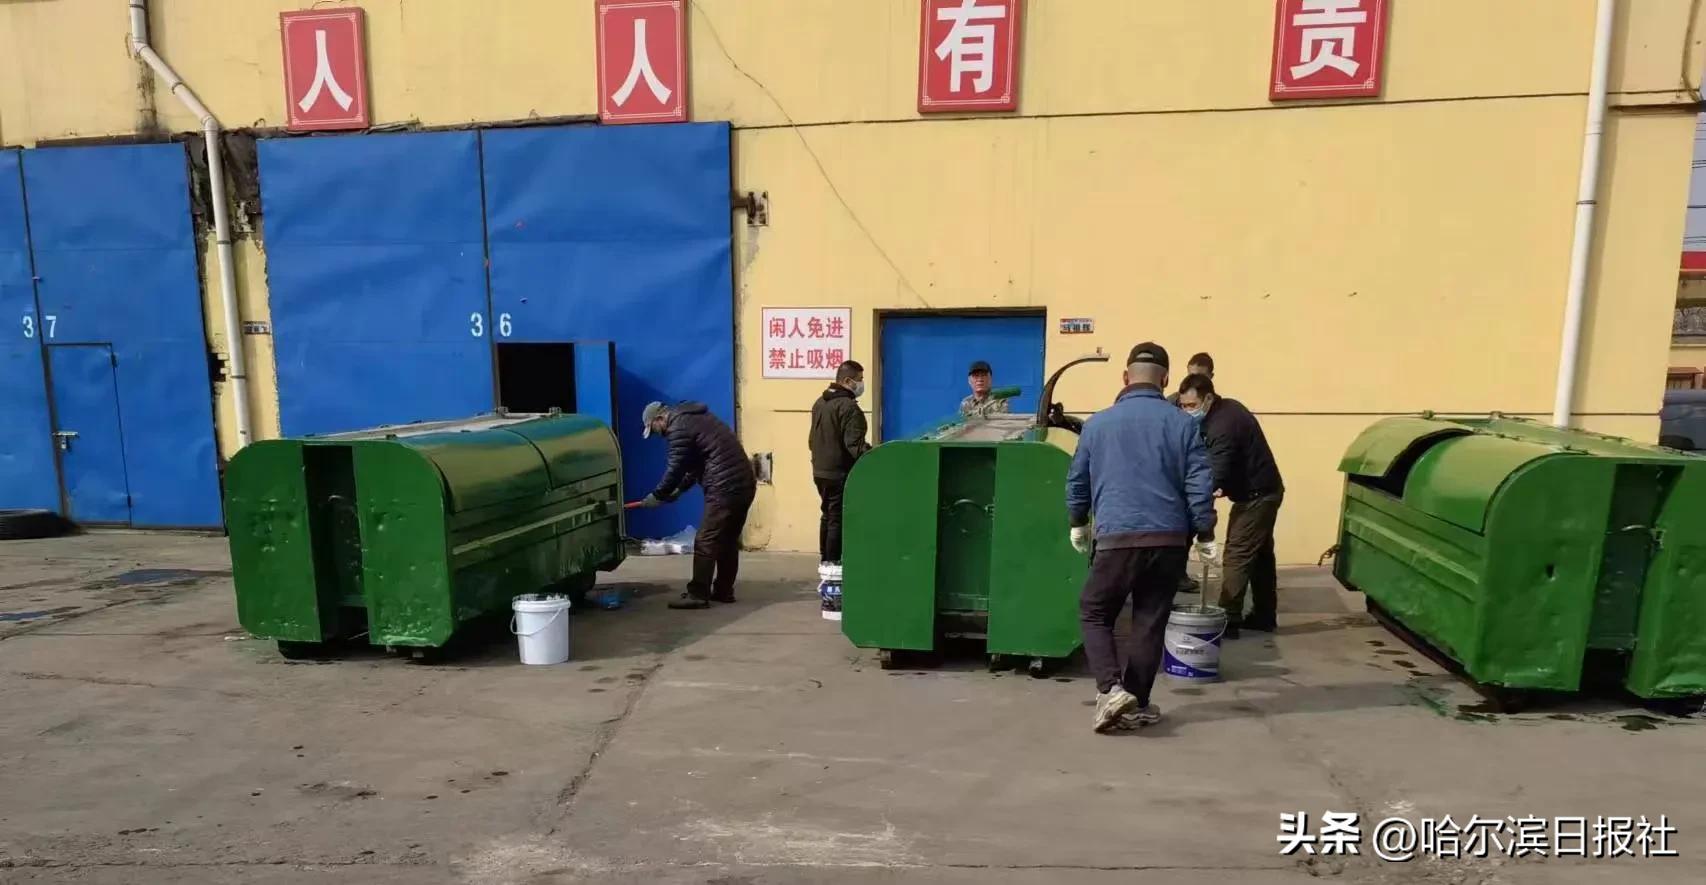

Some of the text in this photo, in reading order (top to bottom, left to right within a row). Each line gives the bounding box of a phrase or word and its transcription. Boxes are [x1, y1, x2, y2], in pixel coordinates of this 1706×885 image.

[298, 0, 1367, 113] 人 人 有 责
[769, 316, 844, 338] 闲人免进
[768, 347, 844, 369] 禁止吸烟
